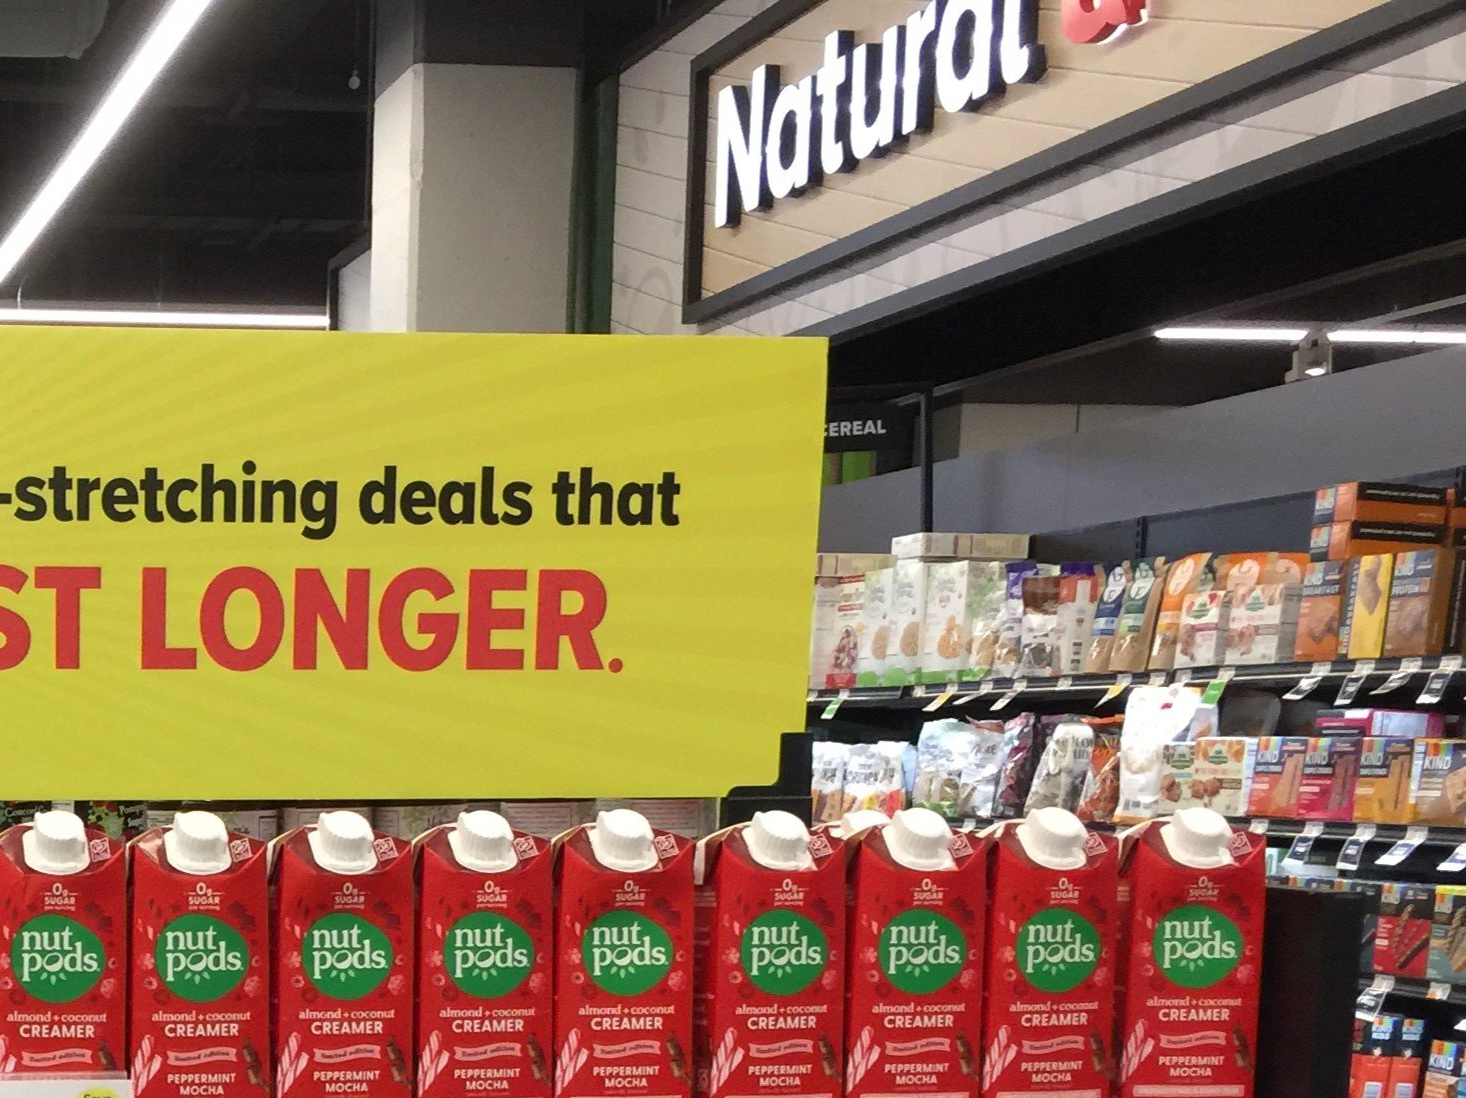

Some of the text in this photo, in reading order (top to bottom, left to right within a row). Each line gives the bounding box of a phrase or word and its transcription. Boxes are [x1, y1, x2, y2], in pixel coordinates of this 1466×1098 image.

[359, 466, 533, 526] deals
[552, 466, 680, 527] that
[140, 565, 623, 673] LONGER.
[1424, 757, 1451, 769] KIND
[189, 897, 219, 905] SUGAR
[22, 924, 72, 950] nut
[165, 924, 216, 950] nut
[454, 923, 504, 947] nut
[751, 922, 799, 945] nut
[1163, 916, 1211, 939] nut
[167, 941, 244, 981] pods
[455, 939, 530, 978] pods
[751, 937, 823, 976] pods
[1164, 931, 1237, 968] pods
[22, 942, 100, 982] pods
[452, 1019, 524, 1032] CREAMER
[747, 1016, 816, 1030] CREAMER
[1158, 1008, 1230, 1021] CREAMER
[19, 1024, 95, 1038] CREAMER
[164, 1024, 239, 1037] CREAMER
[167, 1073, 236, 1085] PEPPERMINT
[180, 1084, 224, 1095] MOCHA
